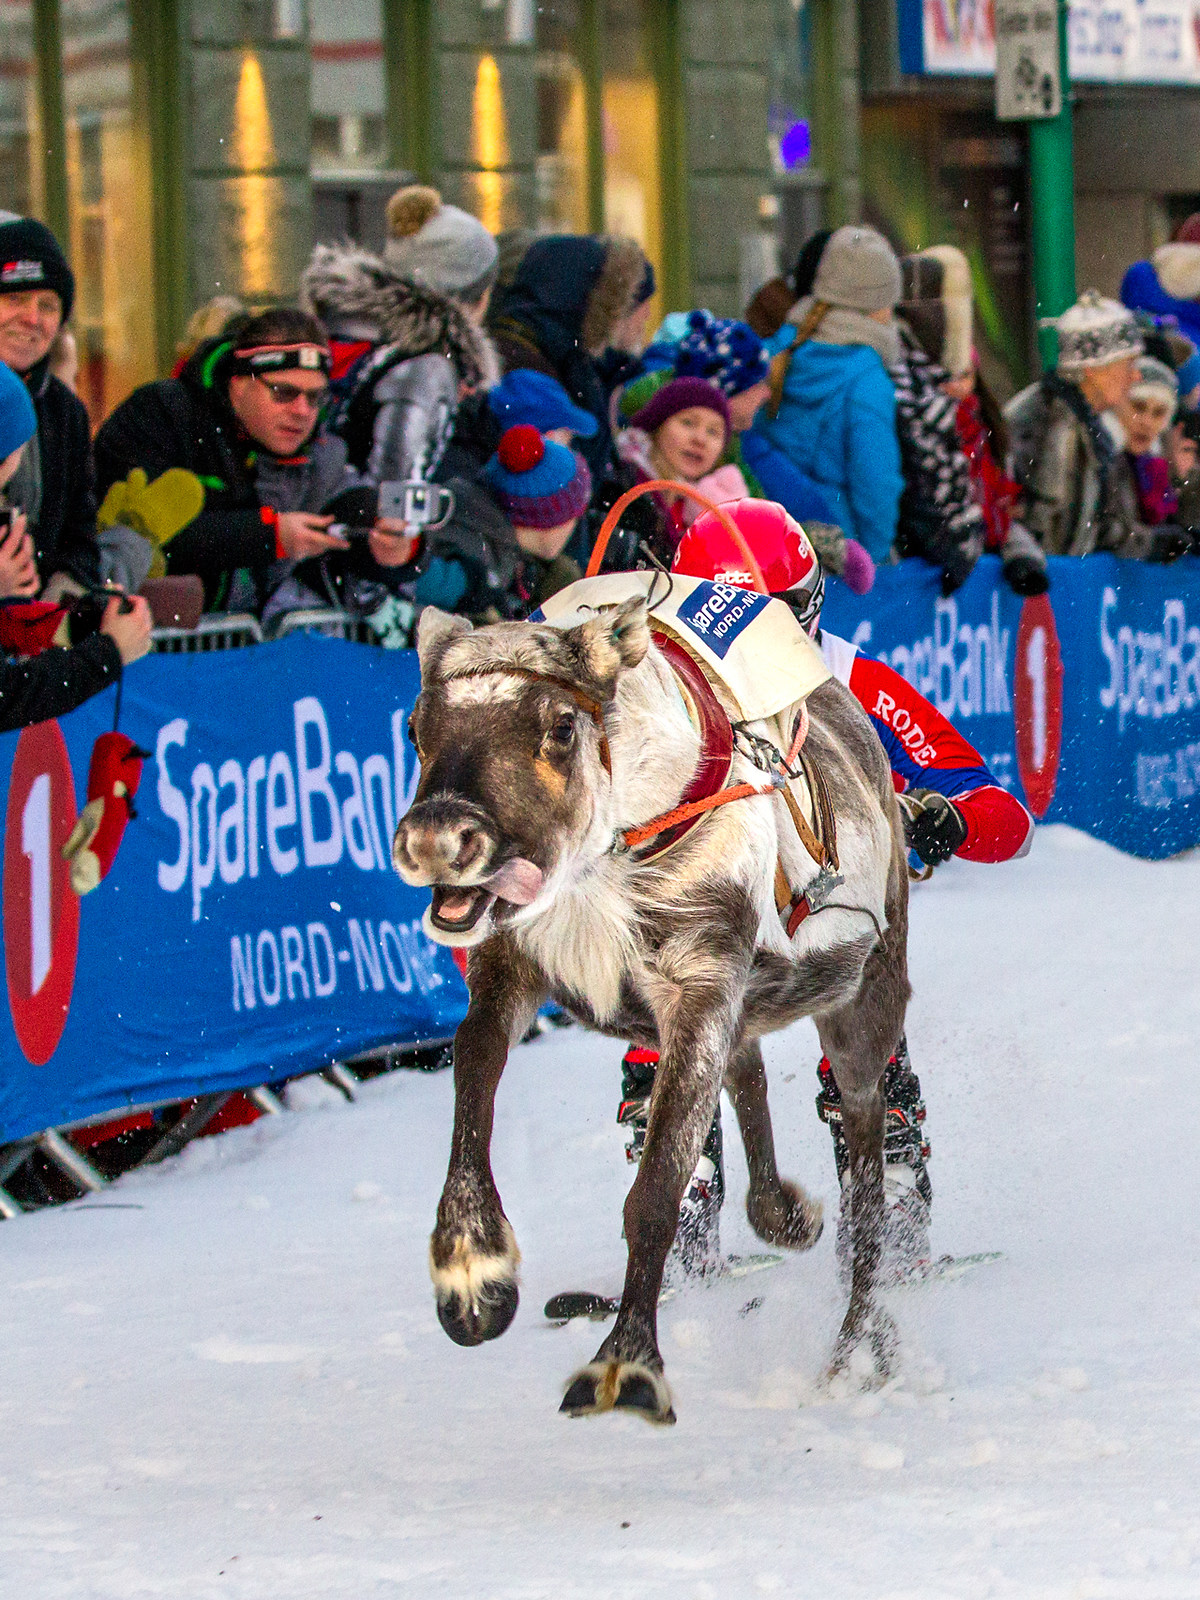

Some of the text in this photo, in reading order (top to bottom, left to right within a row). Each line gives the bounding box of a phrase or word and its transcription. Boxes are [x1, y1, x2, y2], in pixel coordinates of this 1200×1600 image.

[872, 690, 937, 766] RODE
[1027, 626, 1046, 772] 1
[23, 773, 50, 996] 1
